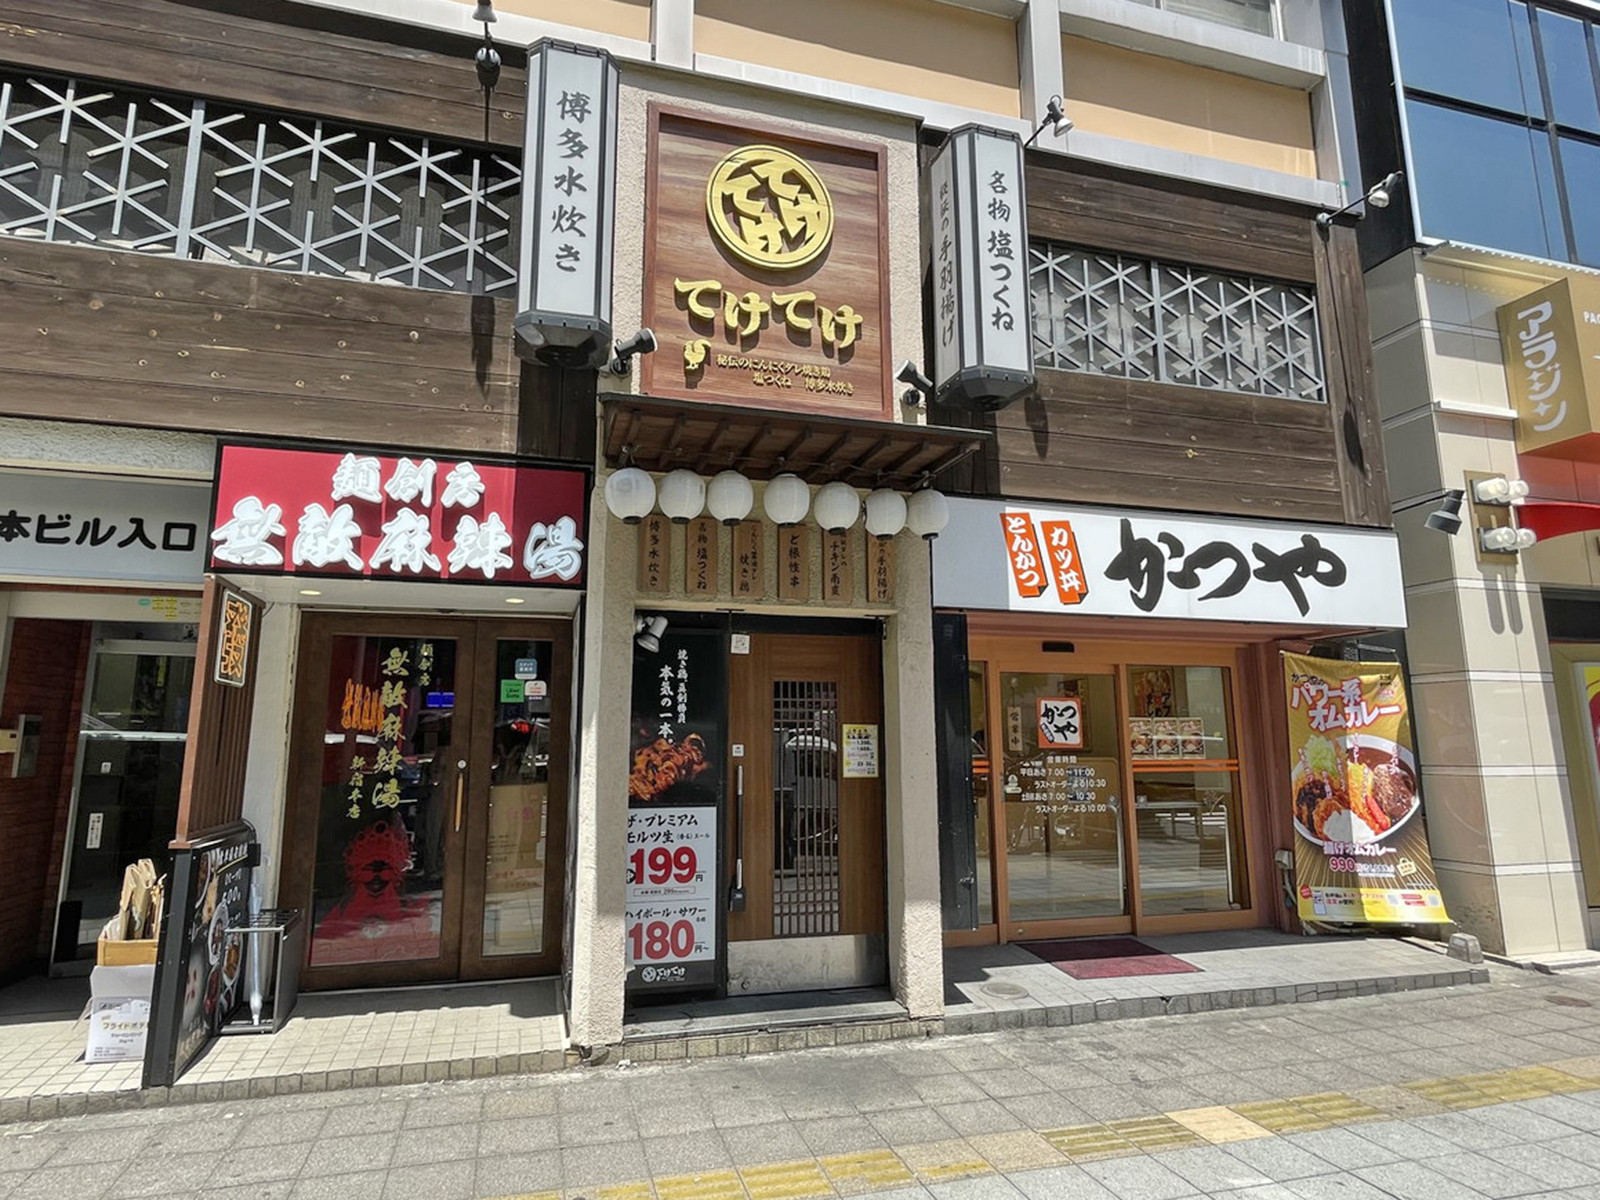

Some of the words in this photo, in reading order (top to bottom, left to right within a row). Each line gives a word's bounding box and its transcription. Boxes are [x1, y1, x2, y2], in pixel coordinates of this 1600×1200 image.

[552, 90, 592, 273] 博多水炊き
[986, 170, 1015, 332] 名物塩つくね
[674, 277, 864, 350] てけてけ
[752, 372, 791, 388] 塩つくね
[804, 378, 855, 396] 博多水炊き
[1518, 300, 1567, 432] アラジン
[0, 509, 197, 552] 本ビル入口
[210, 495, 584, 581] 無敵麻辣湯
[648, 519, 660, 588] 博多水炊き
[696, 520, 709, 591] 名物塩つくね
[1005, 514, 1039, 588] とんかつ
[1048, 525, 1081, 593] カツ丼
[829, 541, 841, 597] チキン南蛮
[1103, 517, 1349, 618] かつや
[371, 646, 410, 810] 無敵麻辣湯
[658, 664, 675, 744] 本気の一本。
[1291, 678, 1363, 709] パワー系
[1308, 700, 1401, 732] オムカレー
[346, 754, 365, 820] 新宿本店
[1046, 755, 1078, 764] 営業時間
